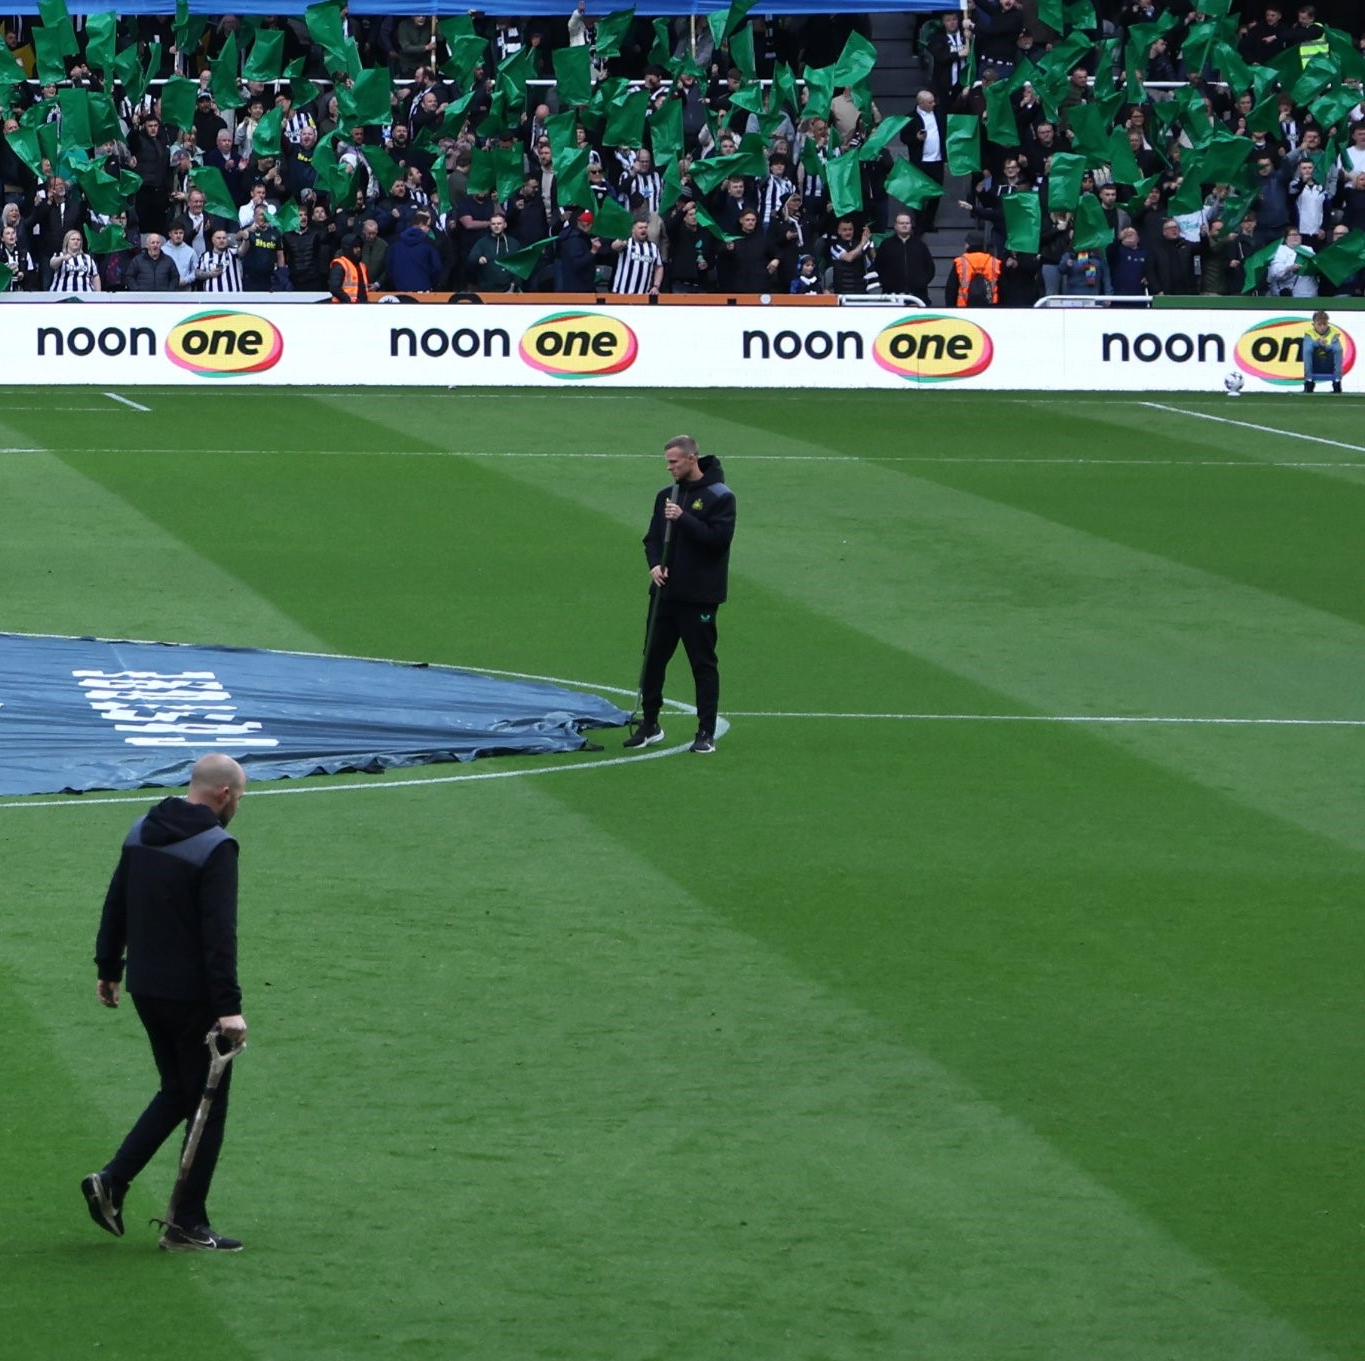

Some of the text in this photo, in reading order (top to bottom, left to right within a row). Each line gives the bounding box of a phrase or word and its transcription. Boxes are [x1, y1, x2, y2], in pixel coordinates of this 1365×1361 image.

[37, 327, 263, 357] noon one
[390, 327, 618, 357] noon one
[743, 330, 973, 360] noon one
[1102, 333, 1305, 364] noon on
